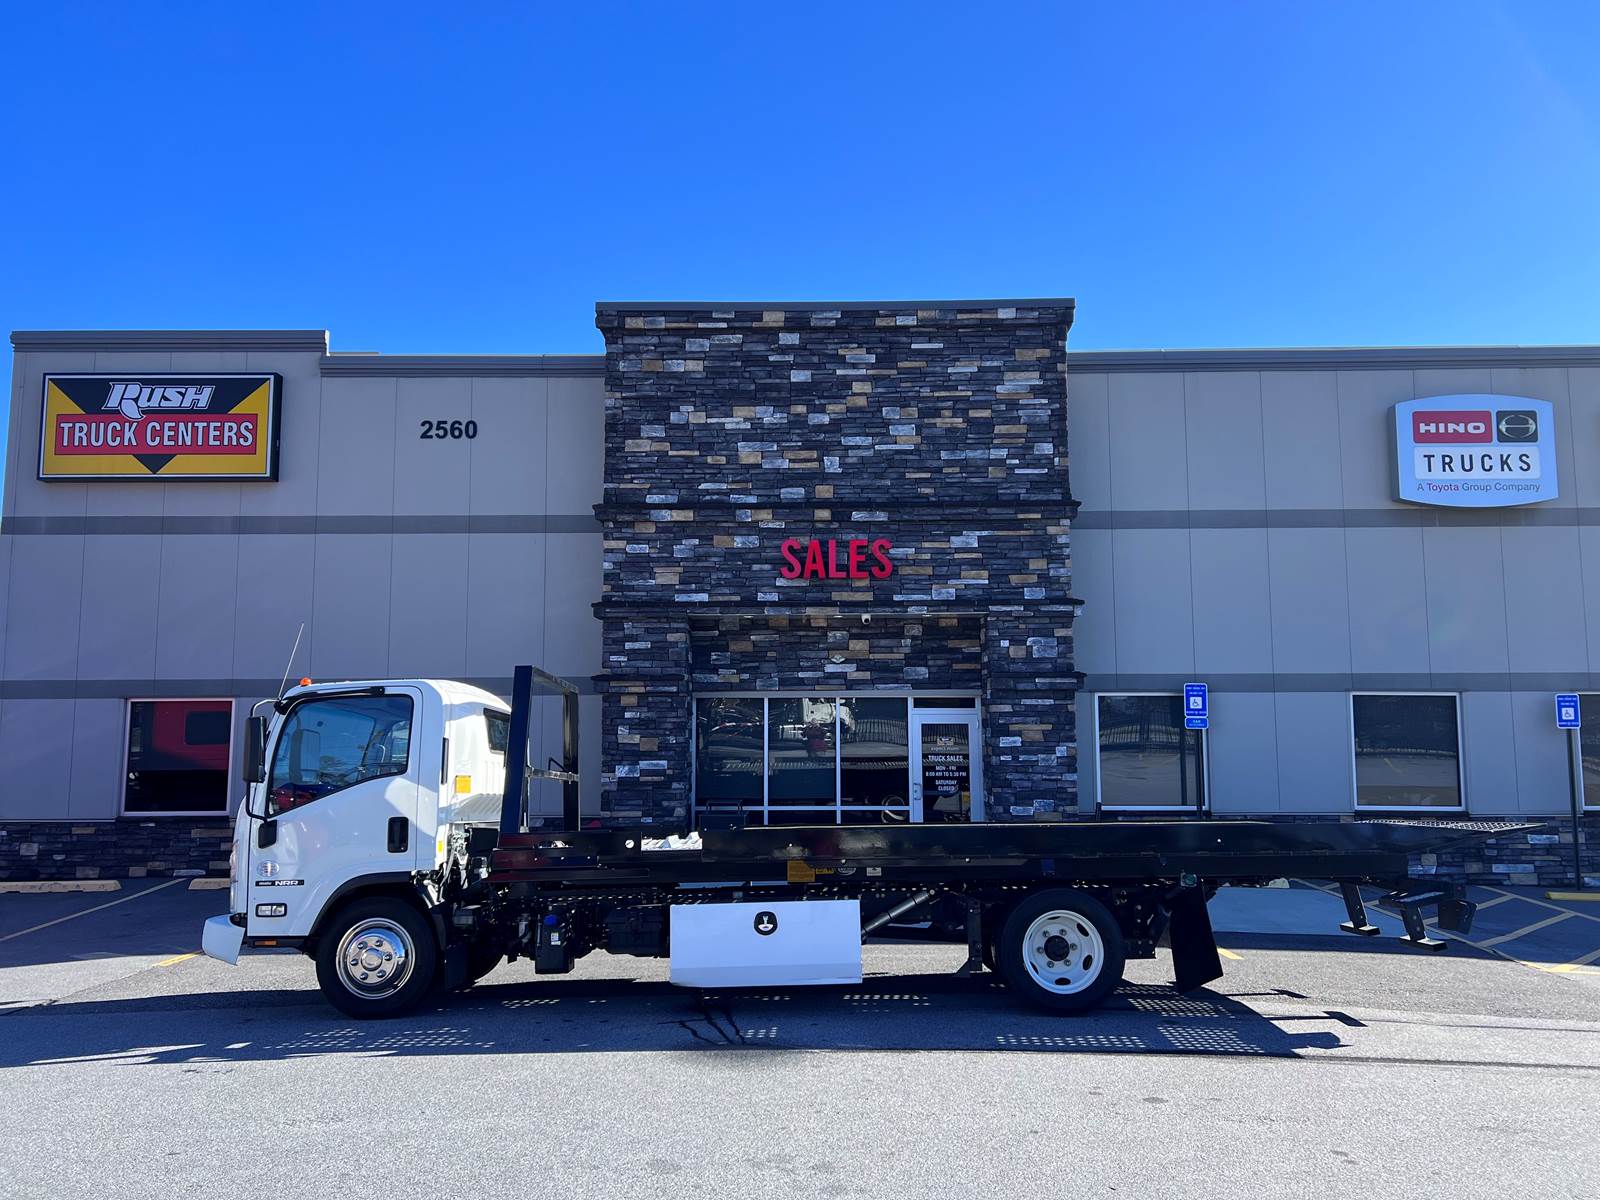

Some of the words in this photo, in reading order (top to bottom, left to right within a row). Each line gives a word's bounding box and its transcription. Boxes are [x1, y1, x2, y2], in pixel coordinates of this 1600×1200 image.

[60, 421, 138, 447] TRUCK
[146, 421, 253, 447] CENTERS
[420, 420, 478, 439] 2560
[1419, 422, 1485, 433] HINO
[1423, 454, 1531, 472] TRUCKS
[1417, 483, 1424, 491] A
[1427, 482, 1459, 493] Toyota
[1462, 482, 1491, 493] Group
[1494, 482, 1540, 493] Company
[780, 538, 894, 579] SALES
